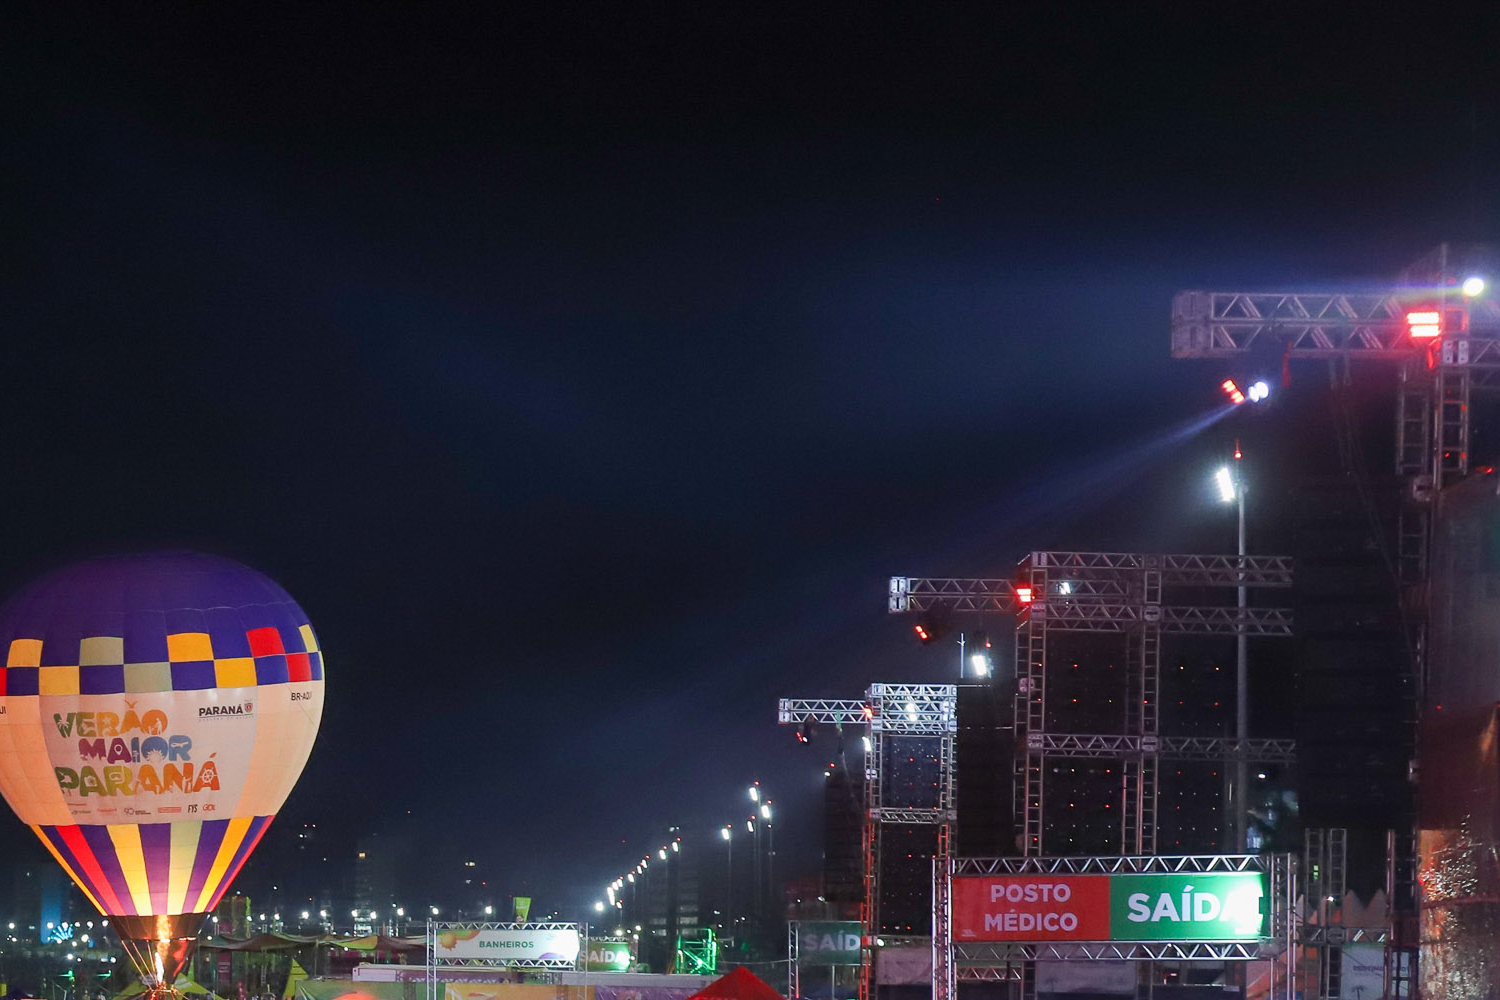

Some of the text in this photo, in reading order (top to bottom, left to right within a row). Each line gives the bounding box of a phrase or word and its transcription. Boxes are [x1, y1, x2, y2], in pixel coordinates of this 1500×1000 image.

[53, 699, 168, 738] VERÃO
[198, 704, 244, 717] PARANÁ
[78, 735, 192, 764] MAIOR
[54, 752, 221, 797] PARANÁ
[990, 884, 1071, 903] POSTO
[984, 909, 1078, 932] MÉDICO
[479, 940, 534, 949] BANHEIROS
[803, 930, 861, 951] SAÍD
